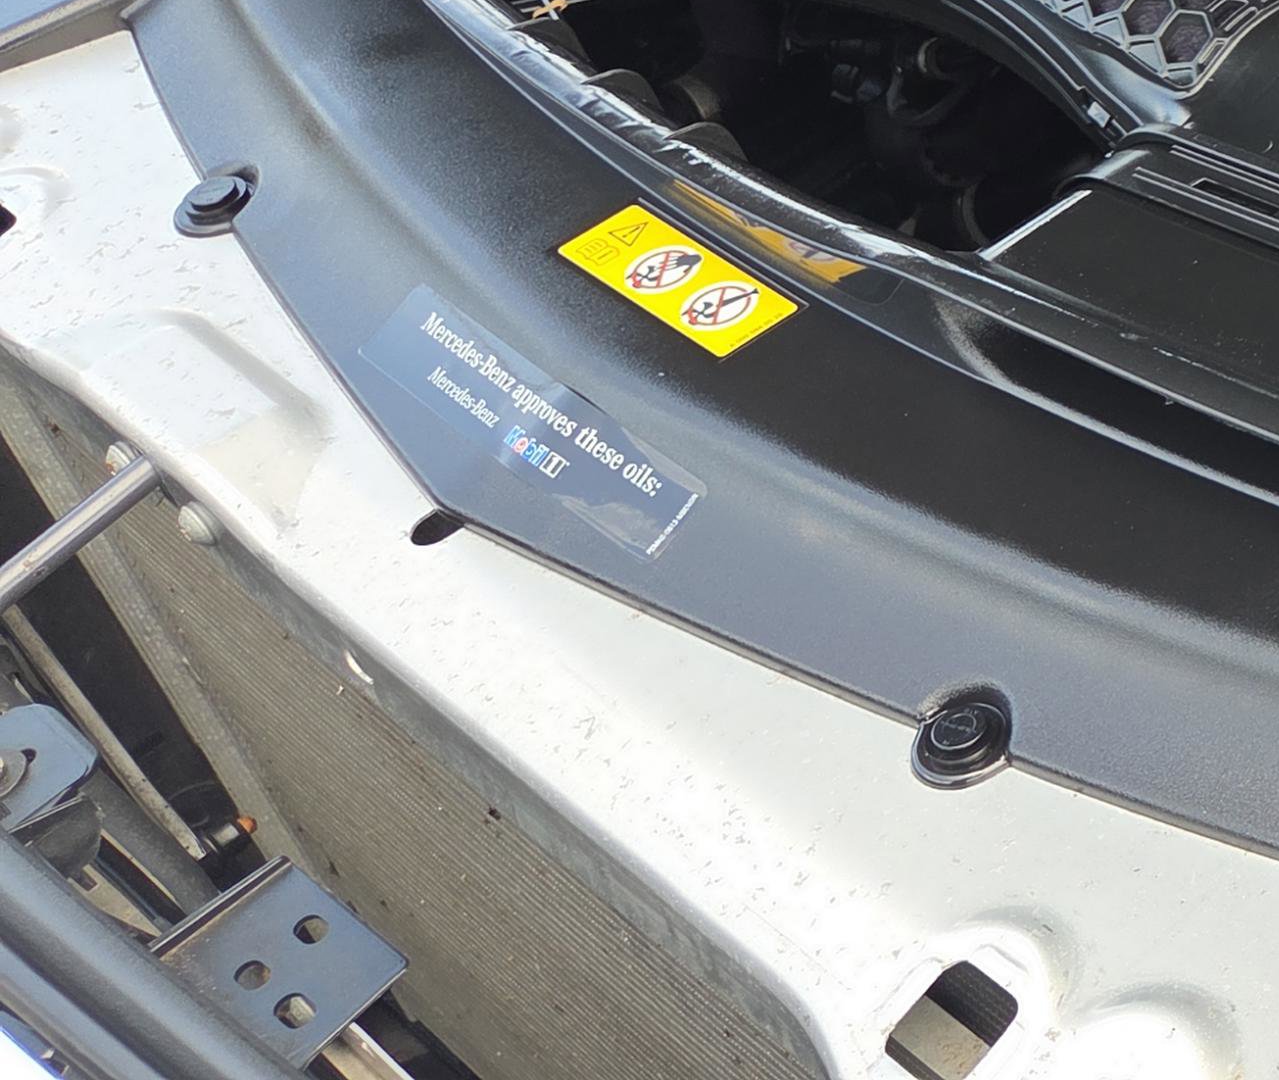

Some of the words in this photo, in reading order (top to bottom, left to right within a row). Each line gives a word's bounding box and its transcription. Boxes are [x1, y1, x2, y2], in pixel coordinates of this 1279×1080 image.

[420, 311, 515, 393] Mercedes-Benz
[511, 383, 578, 438] approves
[574, 426, 625, 471] these
[622, 462, 663, 497] oils:
[427, 366, 500, 428] Mercedes-Benz
[503, 424, 550, 467] Mobil
